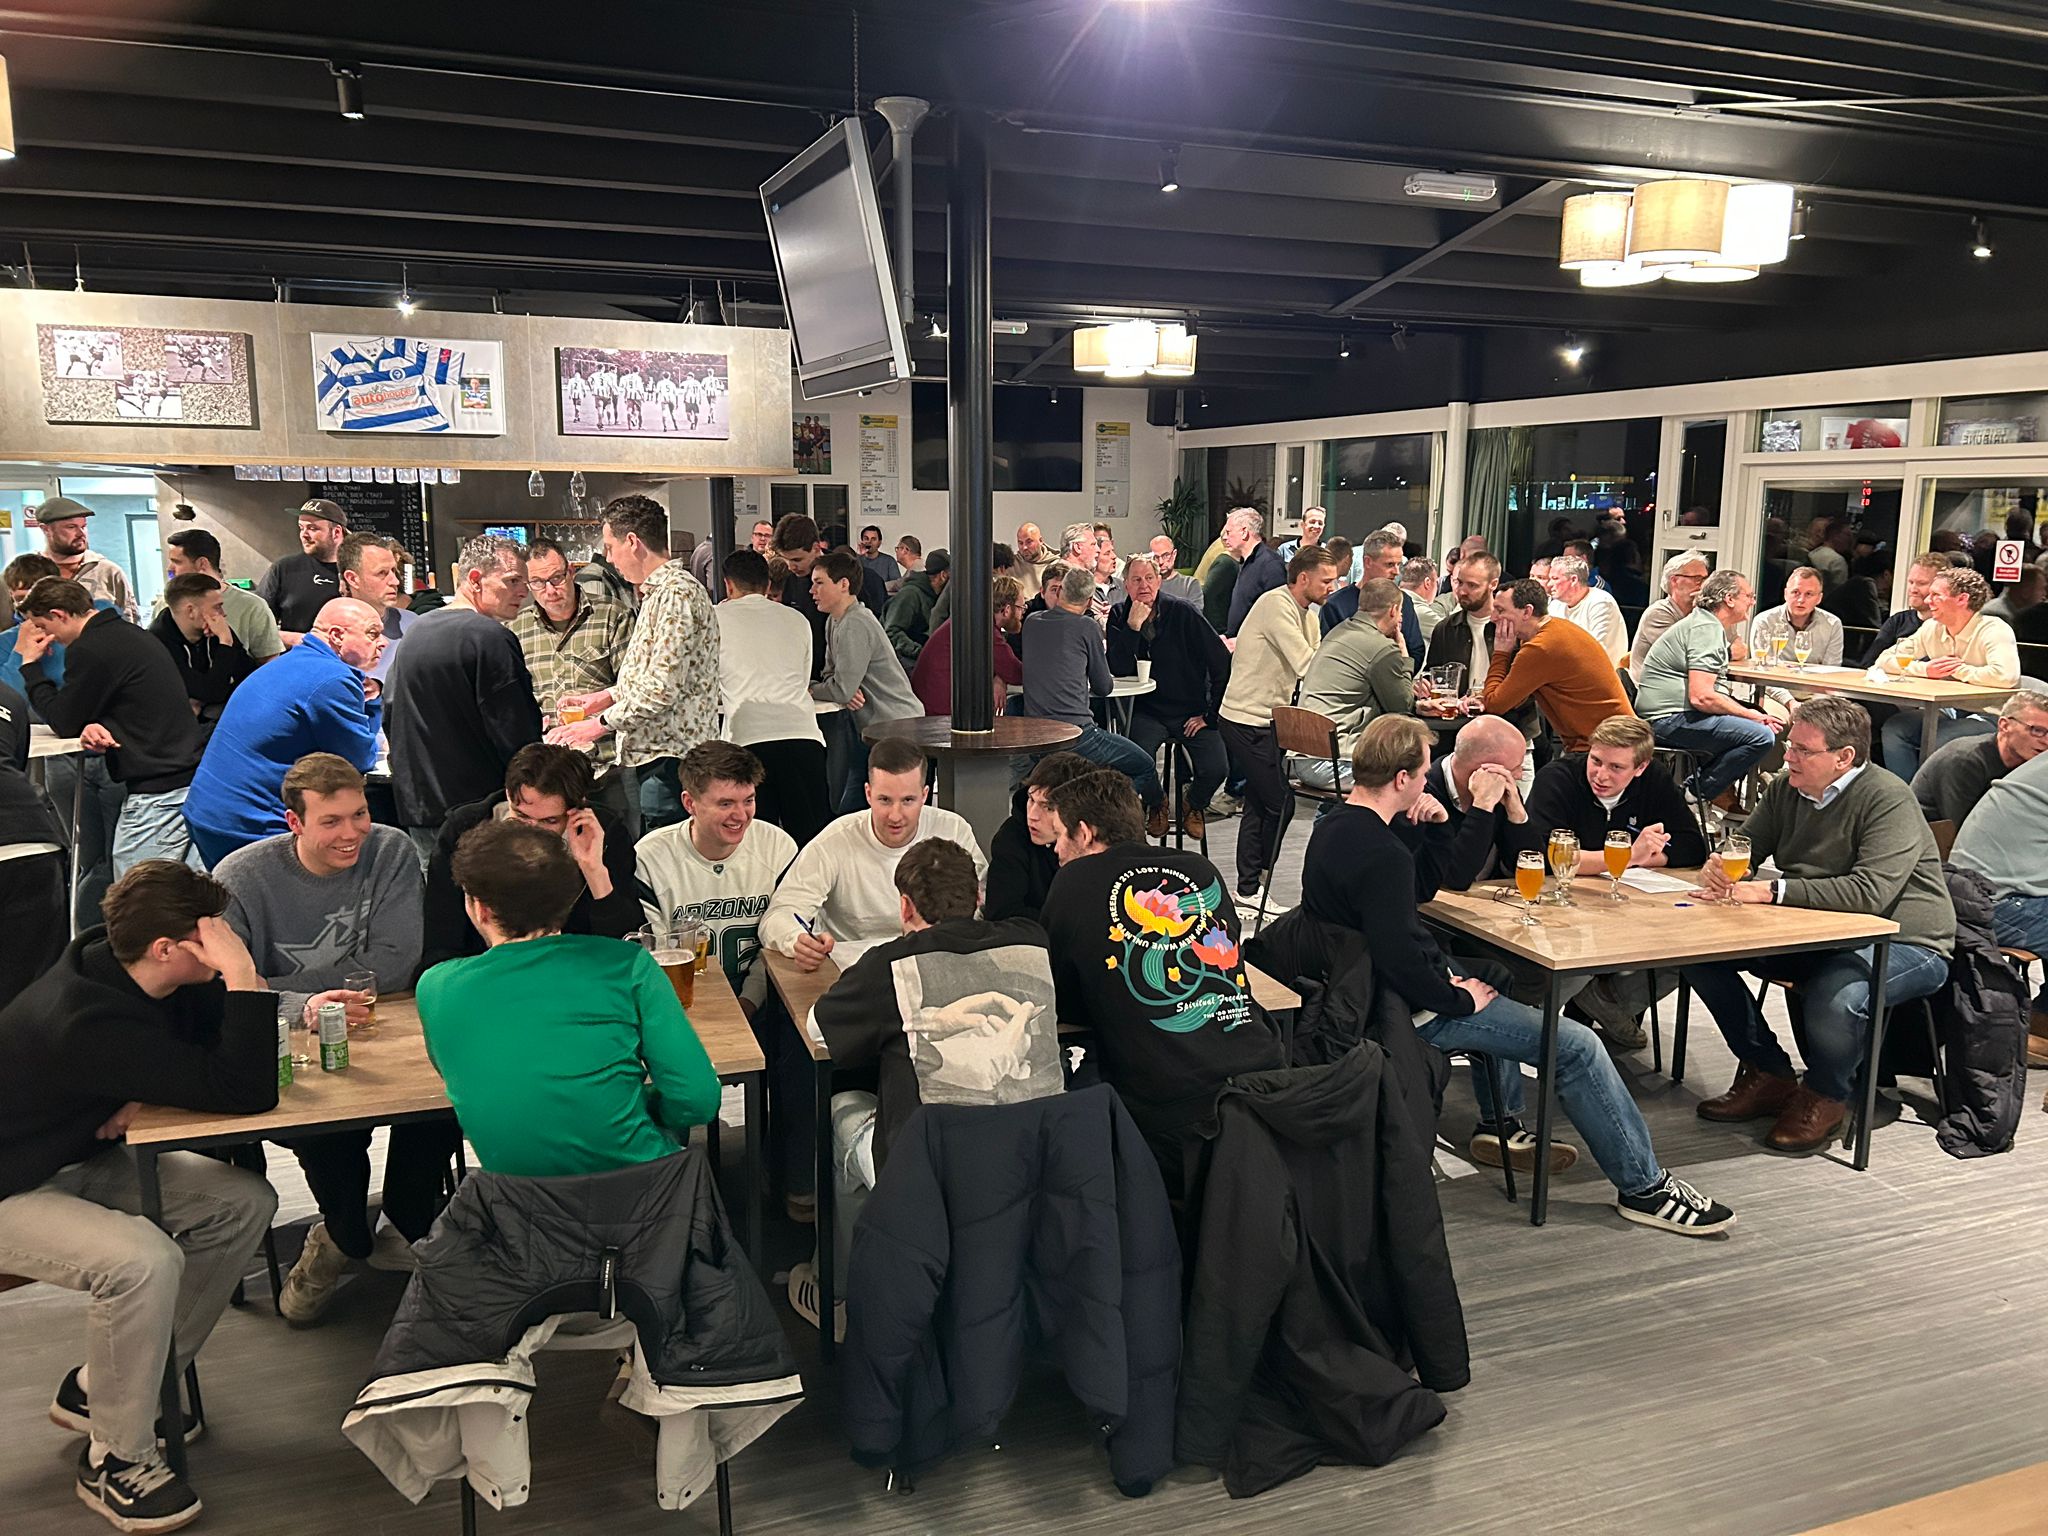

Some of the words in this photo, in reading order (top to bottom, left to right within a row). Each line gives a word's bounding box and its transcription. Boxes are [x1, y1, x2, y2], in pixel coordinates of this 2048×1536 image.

[1162, 868, 1190, 884] MINDS
[1109, 881, 1123, 923] FREEDOM
[1119, 871, 1135, 882] 213
[1152, 941, 1178, 951] WAVE
[1179, 933, 1197, 947] NEW
[1176, 997, 1216, 1013] Spiritual
[1217, 992, 1249, 1006] Freedom
